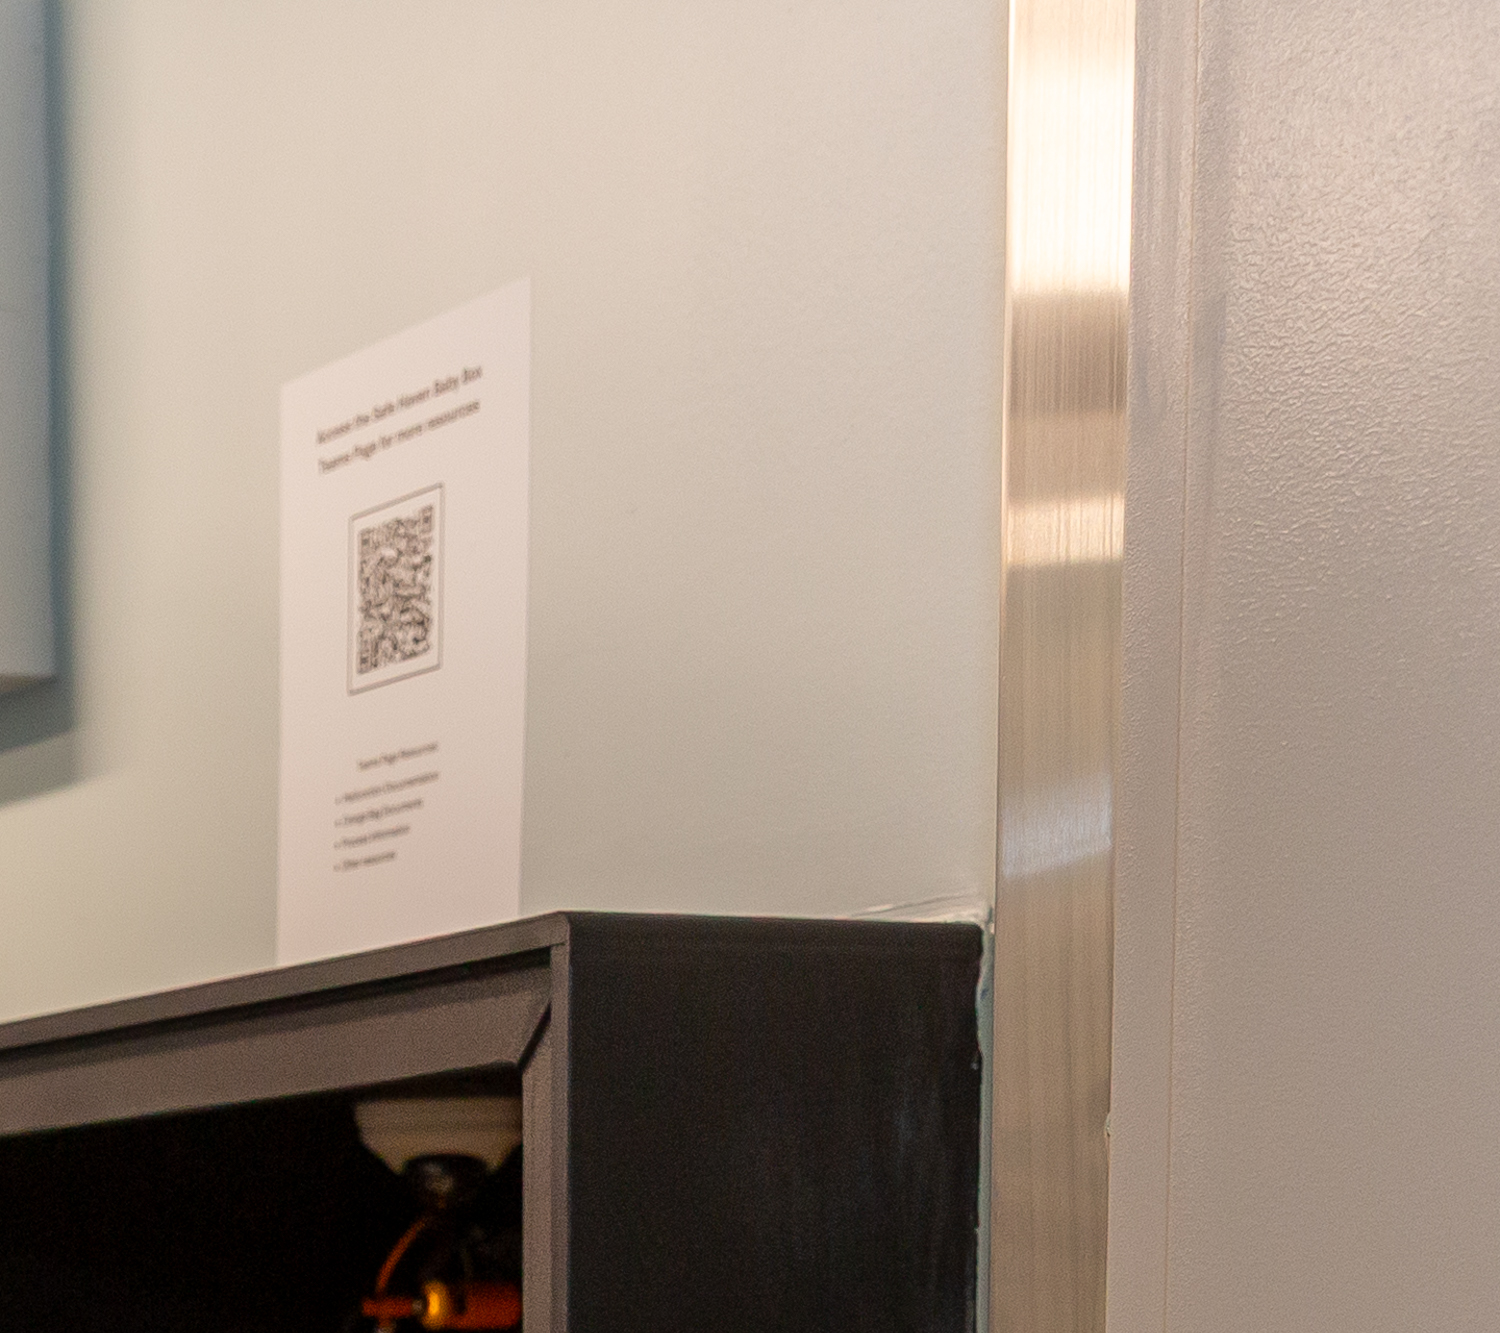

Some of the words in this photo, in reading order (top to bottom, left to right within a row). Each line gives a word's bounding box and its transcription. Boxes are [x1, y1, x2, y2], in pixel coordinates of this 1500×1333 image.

[373, 402, 395, 419] Safe
[398, 388, 430, 408] Haven
[433, 376, 459, 397] Baby
[462, 365, 482, 384] Box
